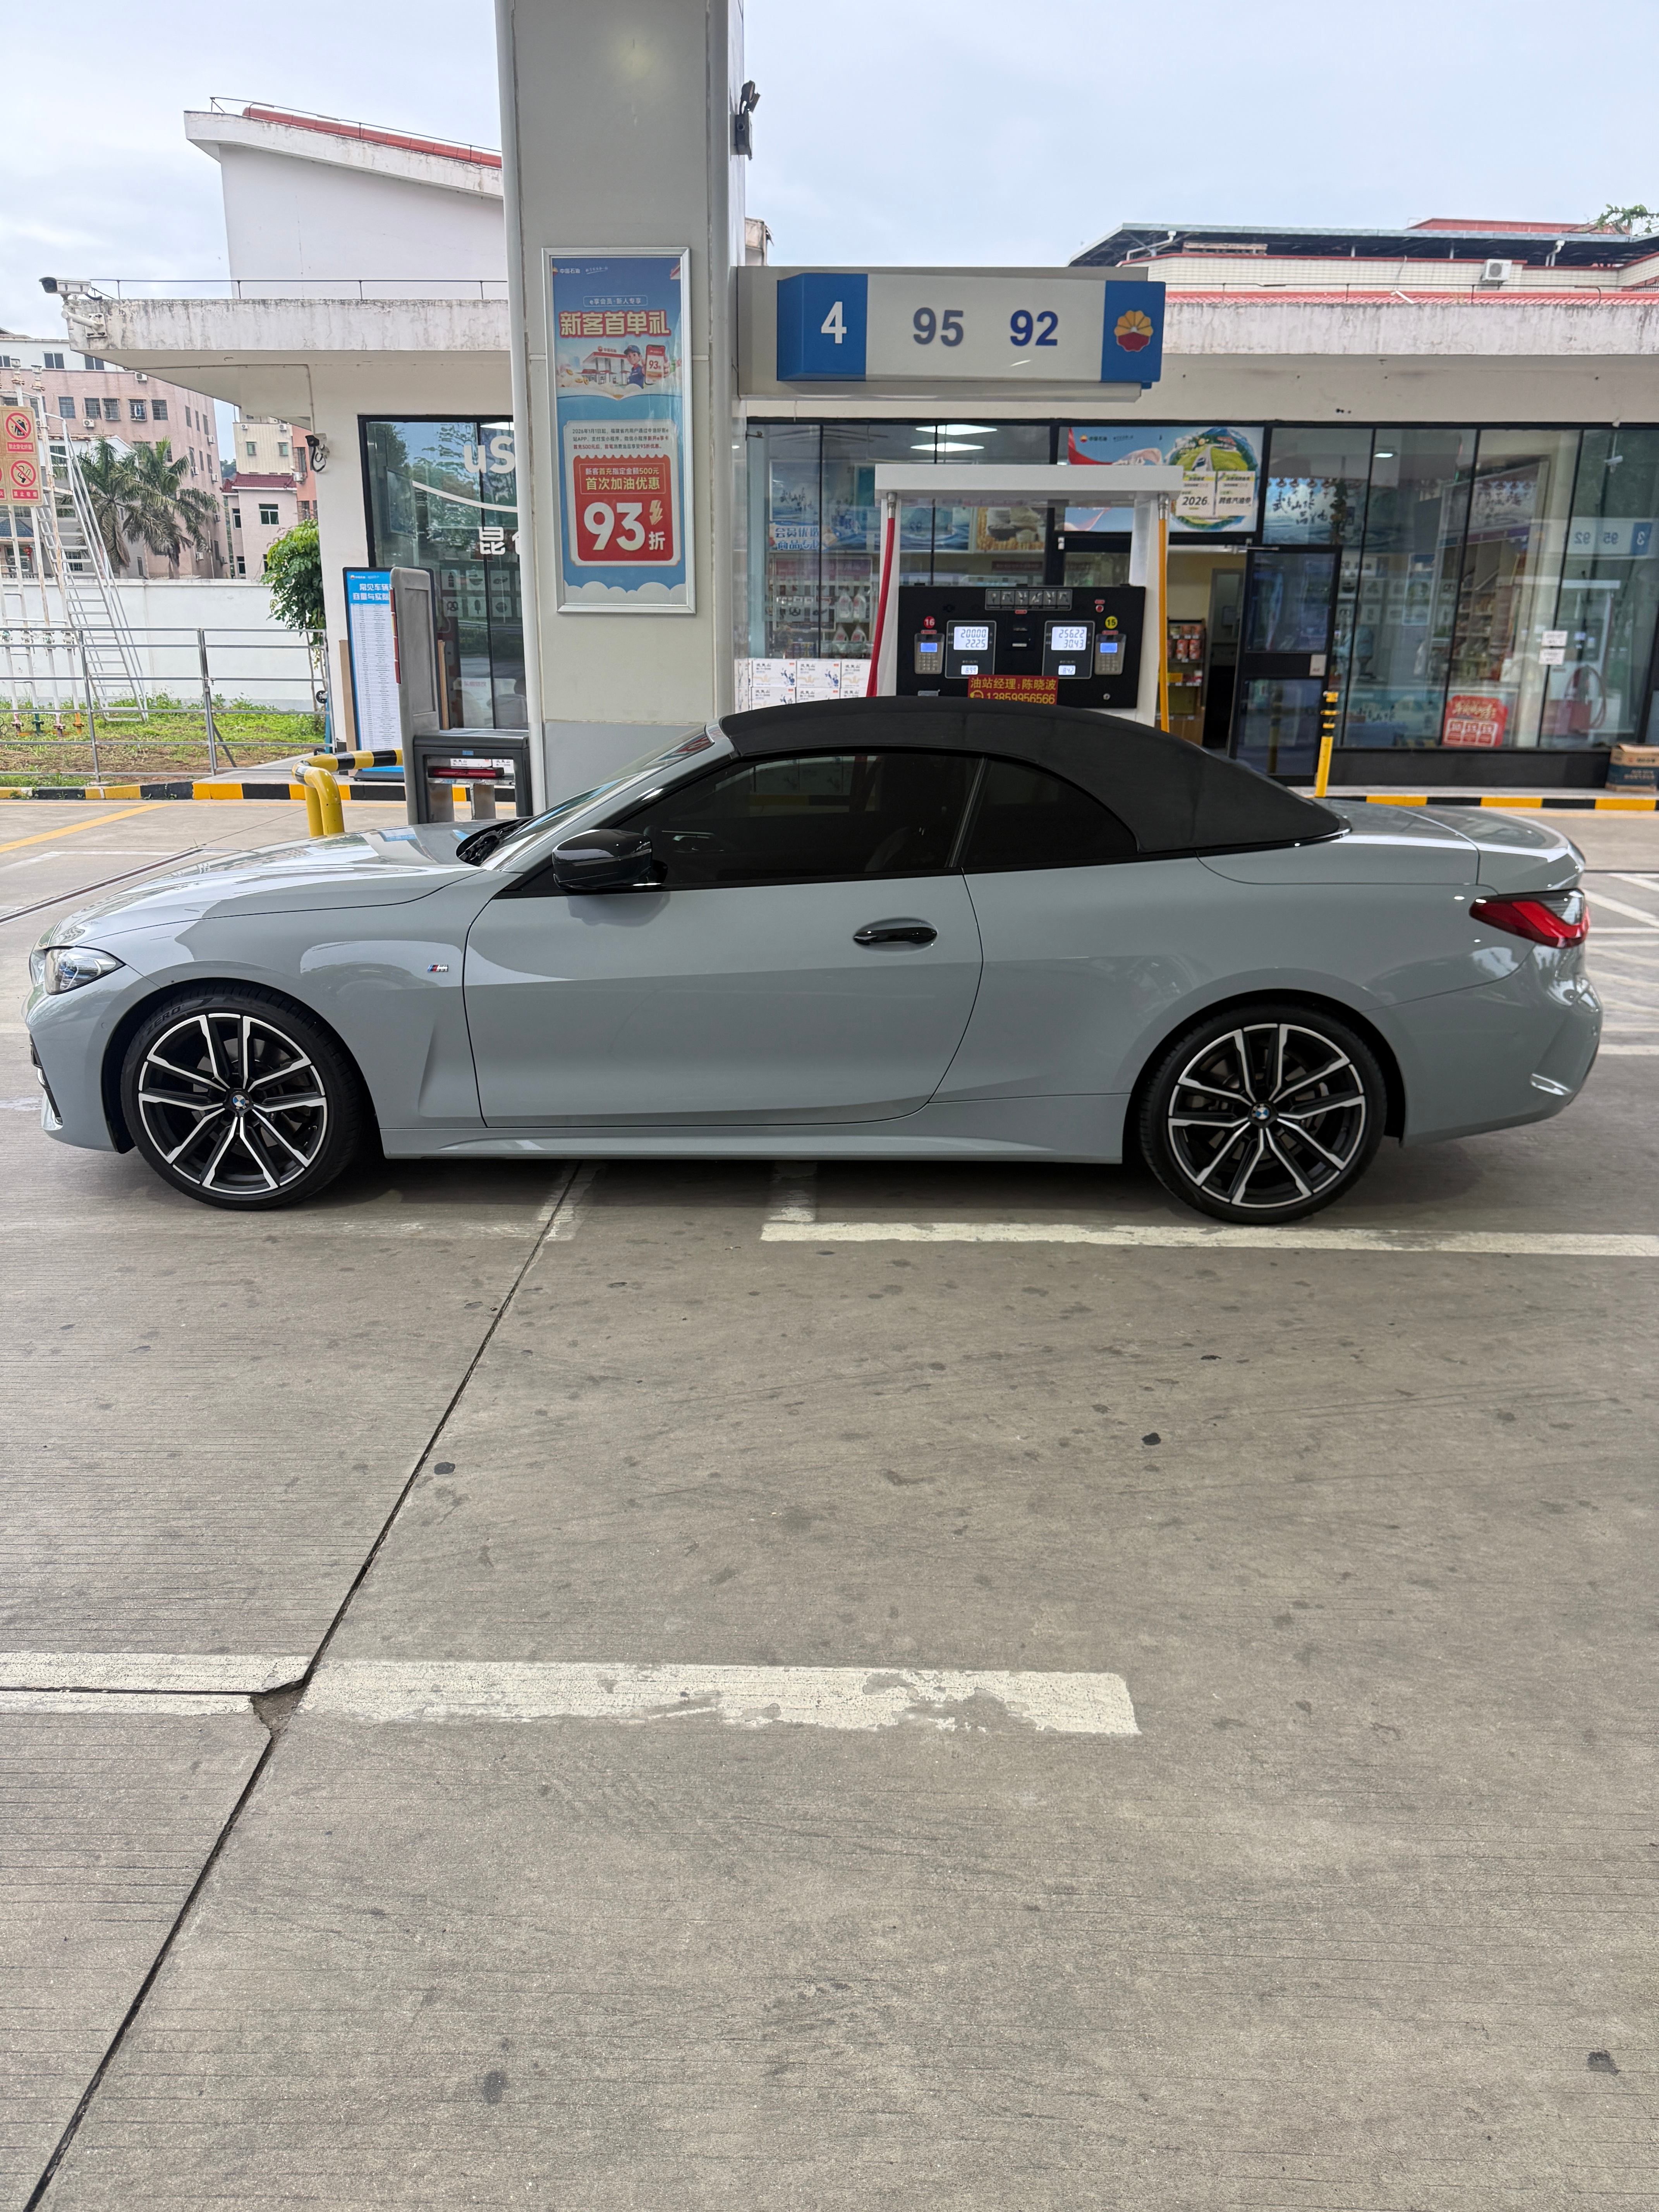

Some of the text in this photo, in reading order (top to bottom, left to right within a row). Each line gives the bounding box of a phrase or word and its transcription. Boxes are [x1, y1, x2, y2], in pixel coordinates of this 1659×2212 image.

[560, 310, 670, 336] 新客首单礼
[821, 301, 847, 344] 4
[913, 307, 964, 347] 95
[1010, 309, 1058, 347] 92
[586, 477, 660, 490] 首次加油优惠
[1182, 496, 1208, 505] 2026
[146, 1006, 181, 1036] ZERO
